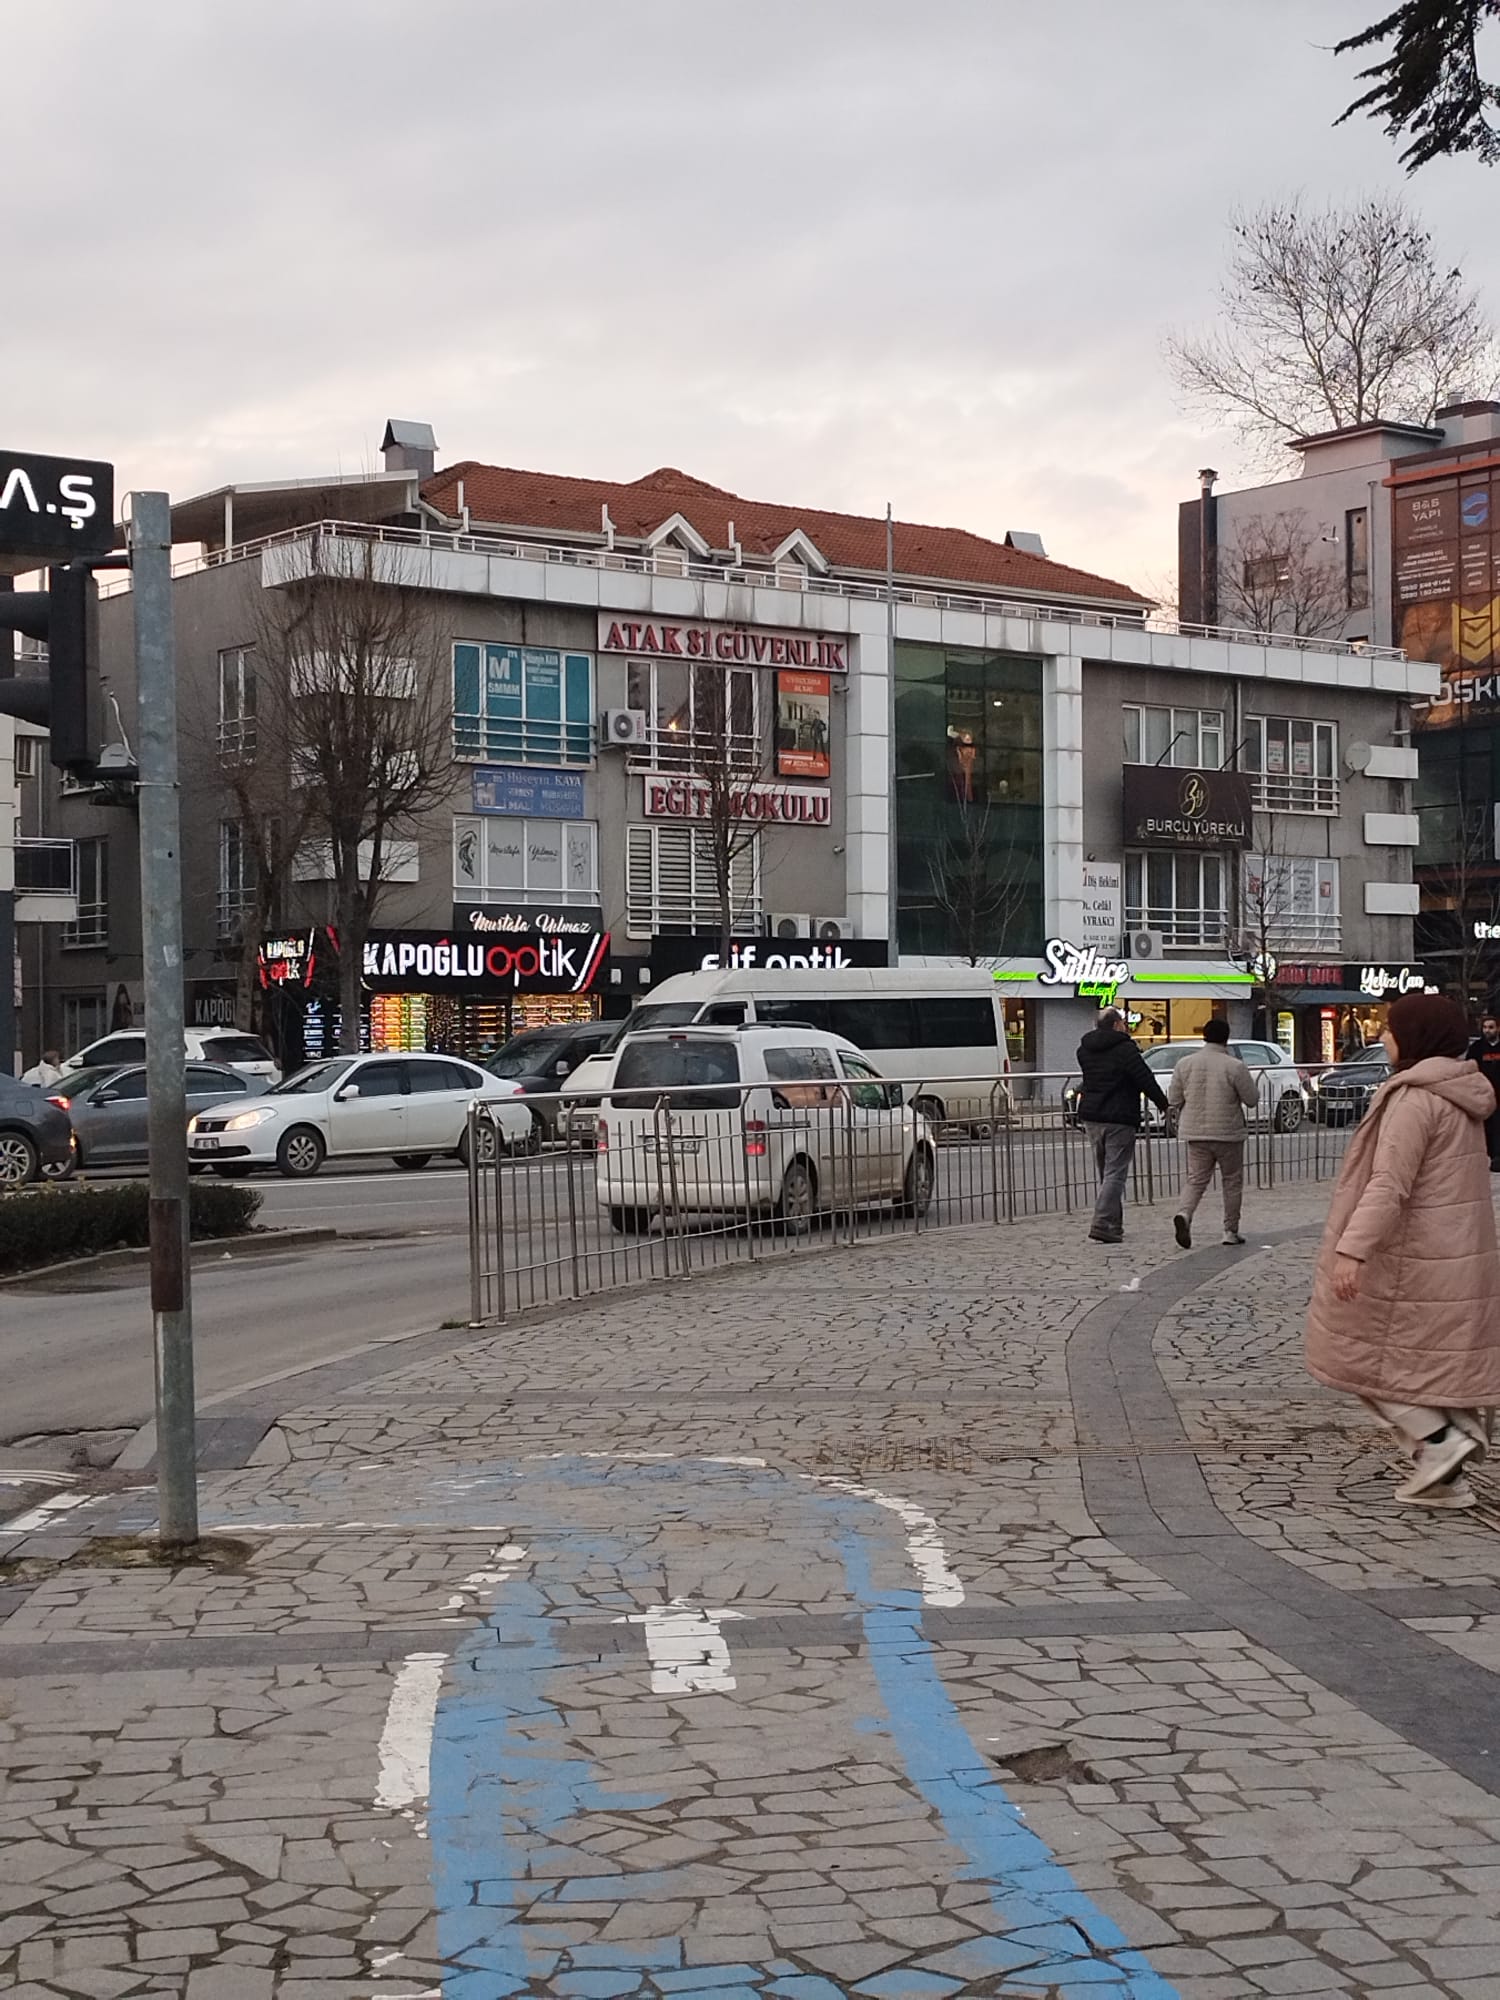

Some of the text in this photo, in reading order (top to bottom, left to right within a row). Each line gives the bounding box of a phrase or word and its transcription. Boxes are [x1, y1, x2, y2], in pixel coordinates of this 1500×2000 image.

[1412, 509, 1441, 521] YAPI
[604, 621, 844, 670] ATAK 81 GÜVENLİK
[1410, 674, 1500, 709] OSK
[554, 774, 582, 787] KAYA
[650, 780, 829, 822] EĞİTM OKULU
[1146, 818, 1191, 834] BURCU
[363, 937, 578, 988] KAPOĞLU optik
[701, 944, 757, 970] eif
[1040, 939, 1130, 985] Sütlüce
[1359, 967, 1398, 997] Yeliz
